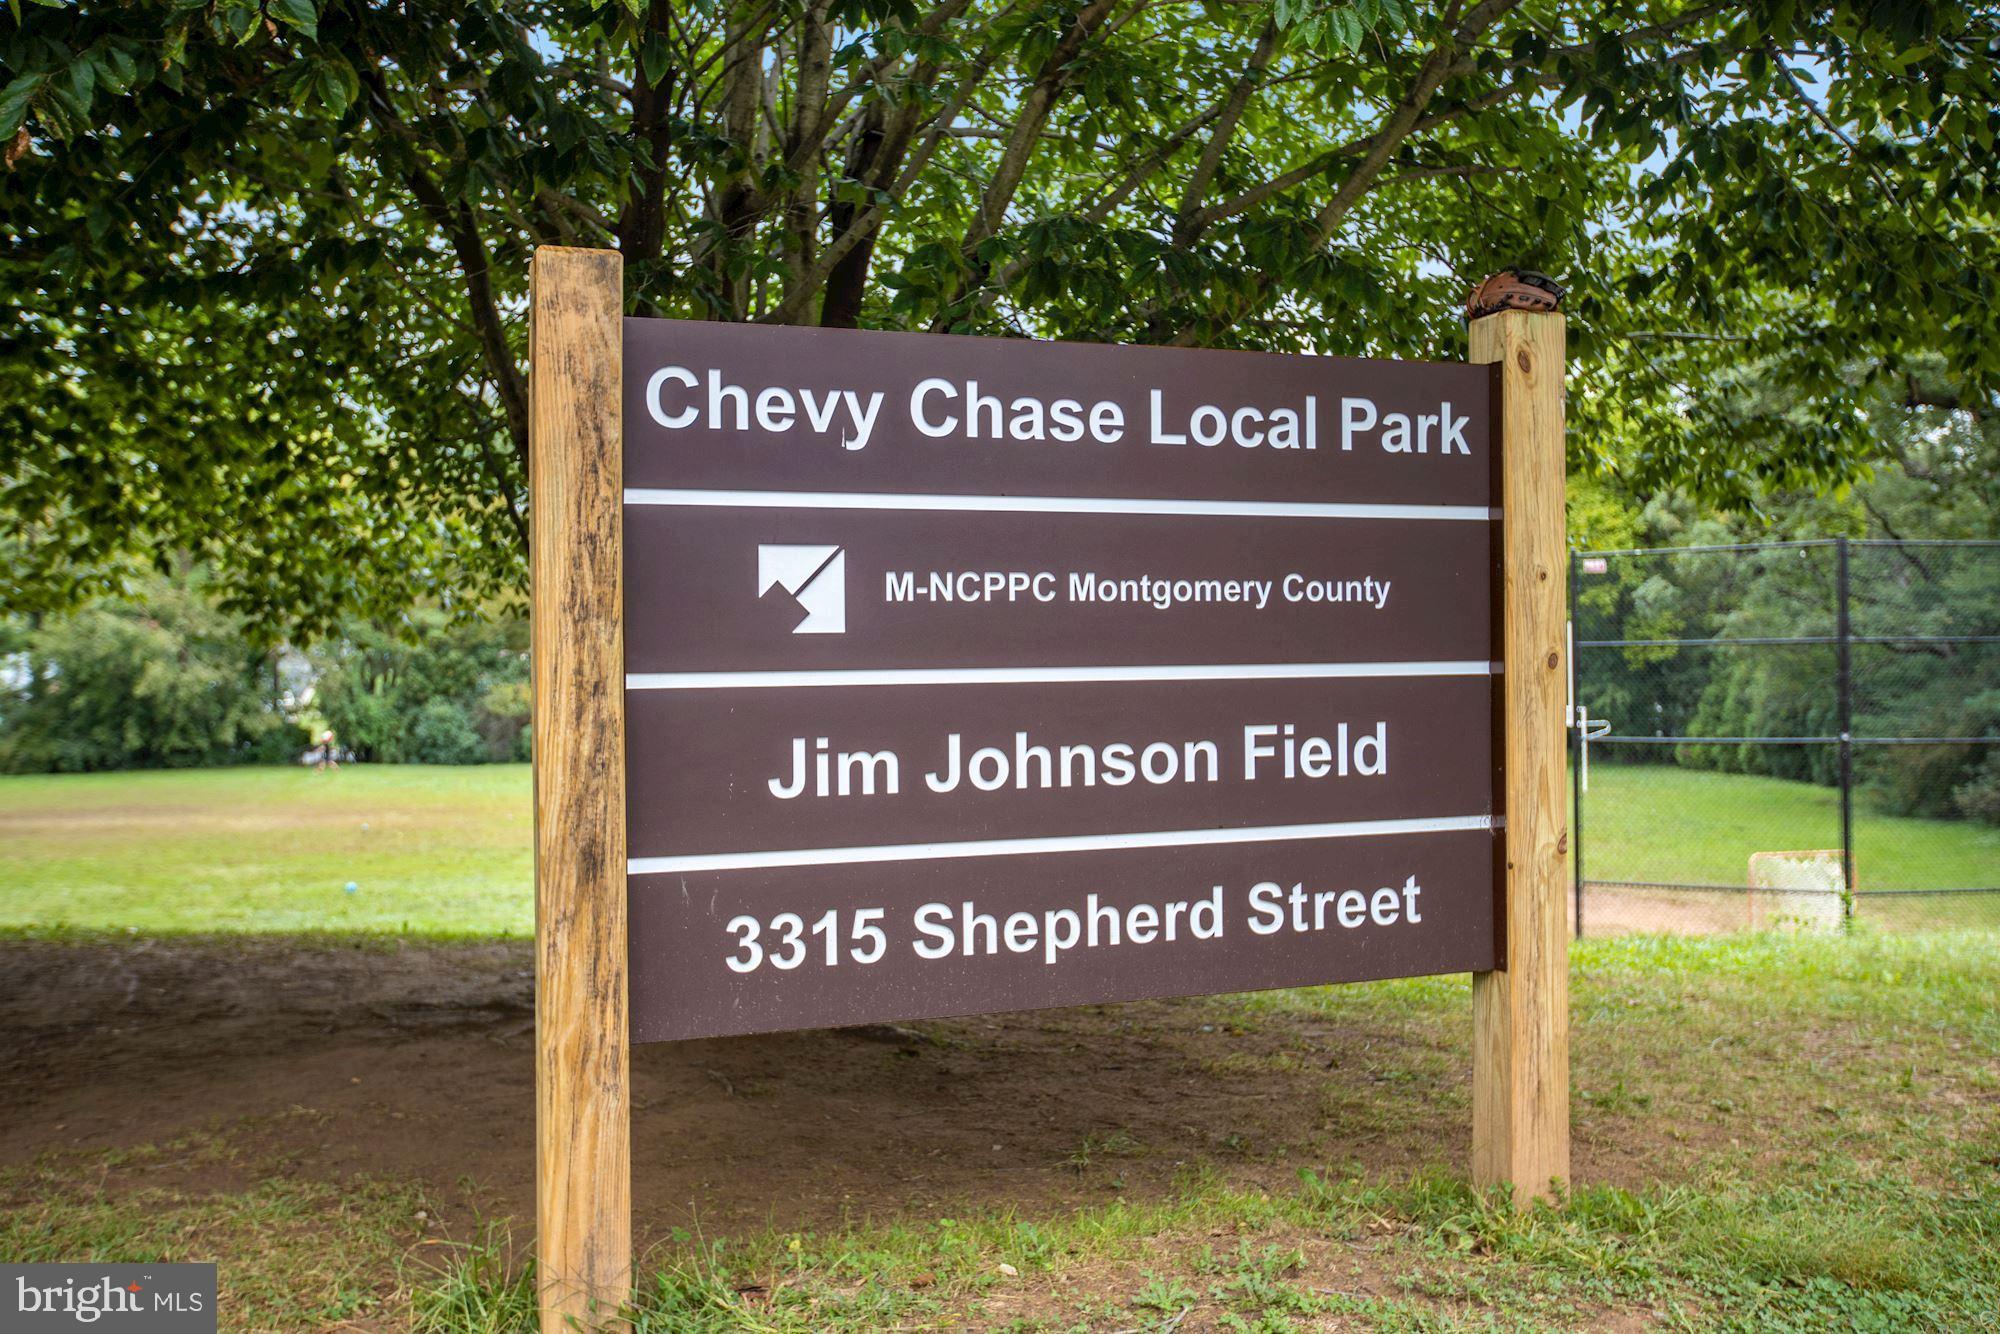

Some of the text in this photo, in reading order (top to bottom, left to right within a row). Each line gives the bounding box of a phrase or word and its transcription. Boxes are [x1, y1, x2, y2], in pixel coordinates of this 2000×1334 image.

[645, 366, 1471, 455] Chevy Chase Local Park
[885, 571, 1391, 610] M-NCPPC Montgomery County
[767, 721, 1387, 800] Jim Johnson Field
[725, 874, 1422, 974] 3315 Shepherd Street
